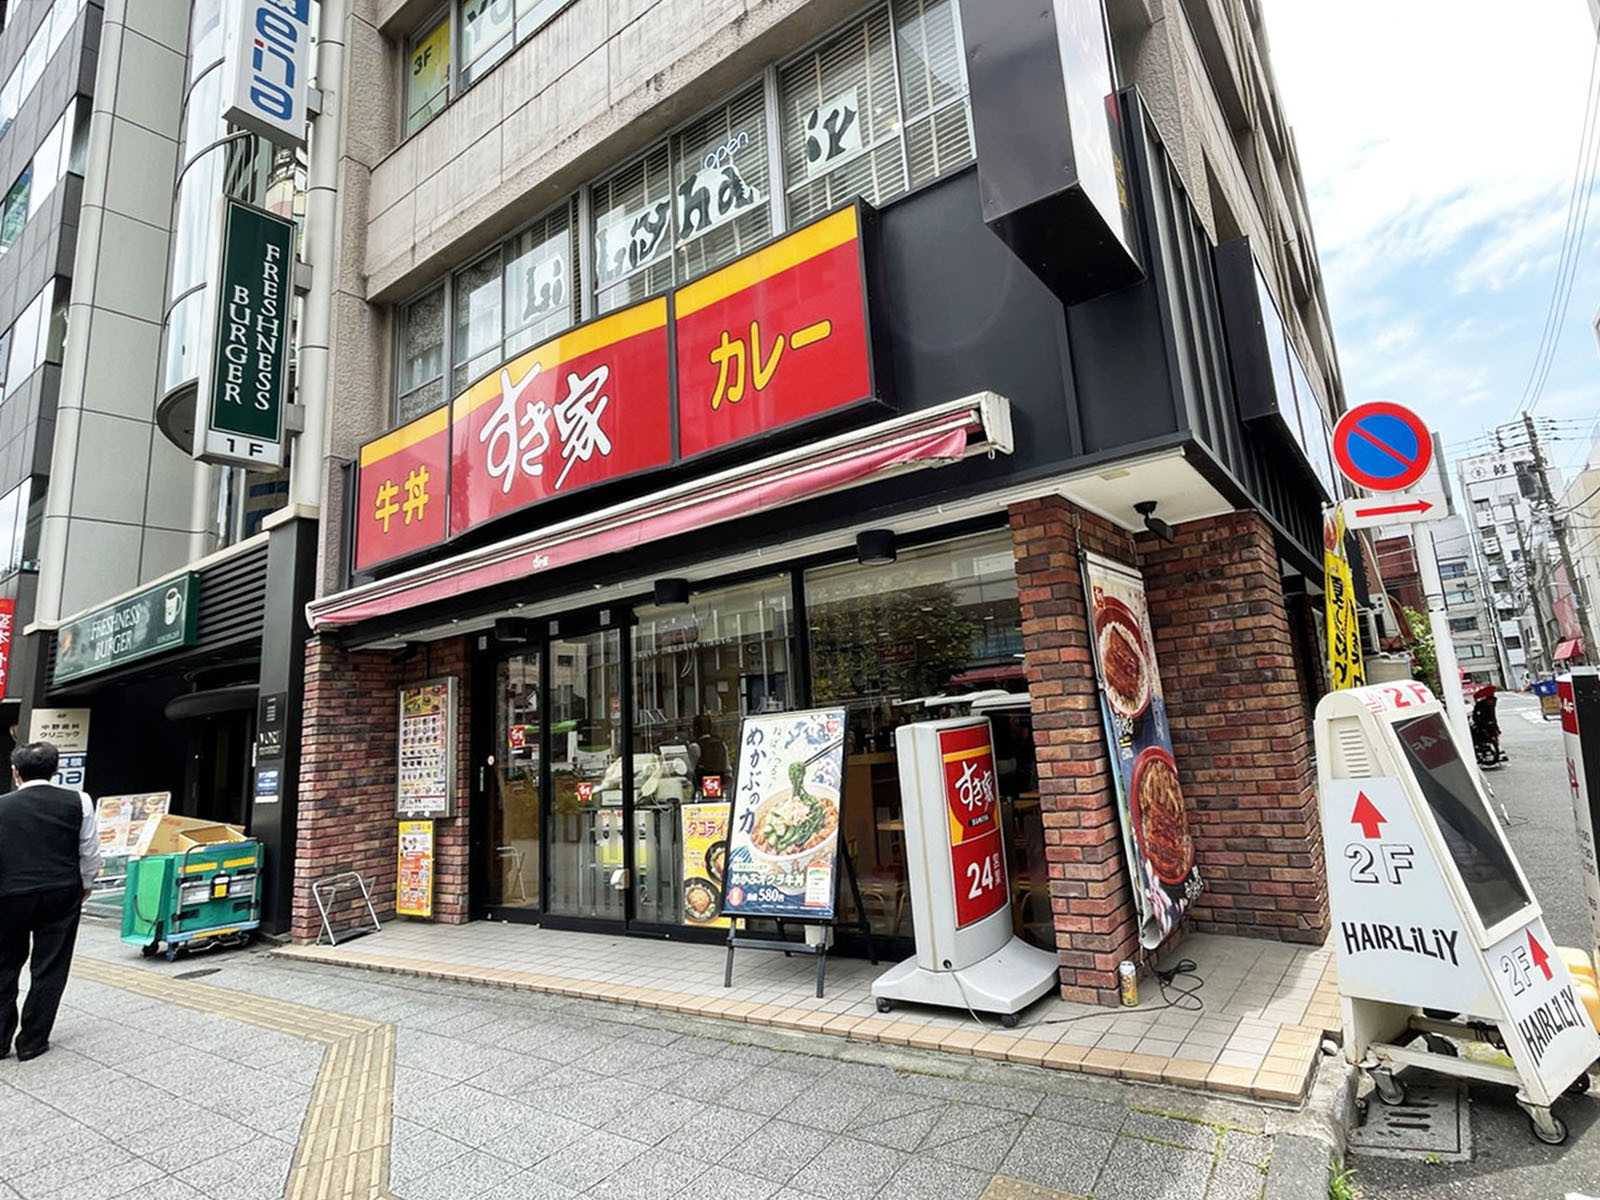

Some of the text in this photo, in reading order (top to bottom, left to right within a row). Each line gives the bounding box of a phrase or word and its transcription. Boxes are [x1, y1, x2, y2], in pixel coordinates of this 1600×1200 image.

[413, 45, 432, 76] 3F
[703, 131, 749, 169] open
[223, 284, 250, 405] BURGER
[254, 243, 280, 410] FRESHNESS
[710, 318, 832, 410] カレー
[226, 438, 263, 456] 1F
[479, 362, 612, 493] すき家
[375, 465, 429, 533] 牛丼
[90, 603, 142, 641] FRESHNESS
[94, 630, 134, 661] BURGER
[1383, 683, 1427, 708] 2F
[967, 856, 993, 900] 24
[1344, 843, 1415, 885] 2F
[1500, 945, 1534, 997] 2F
